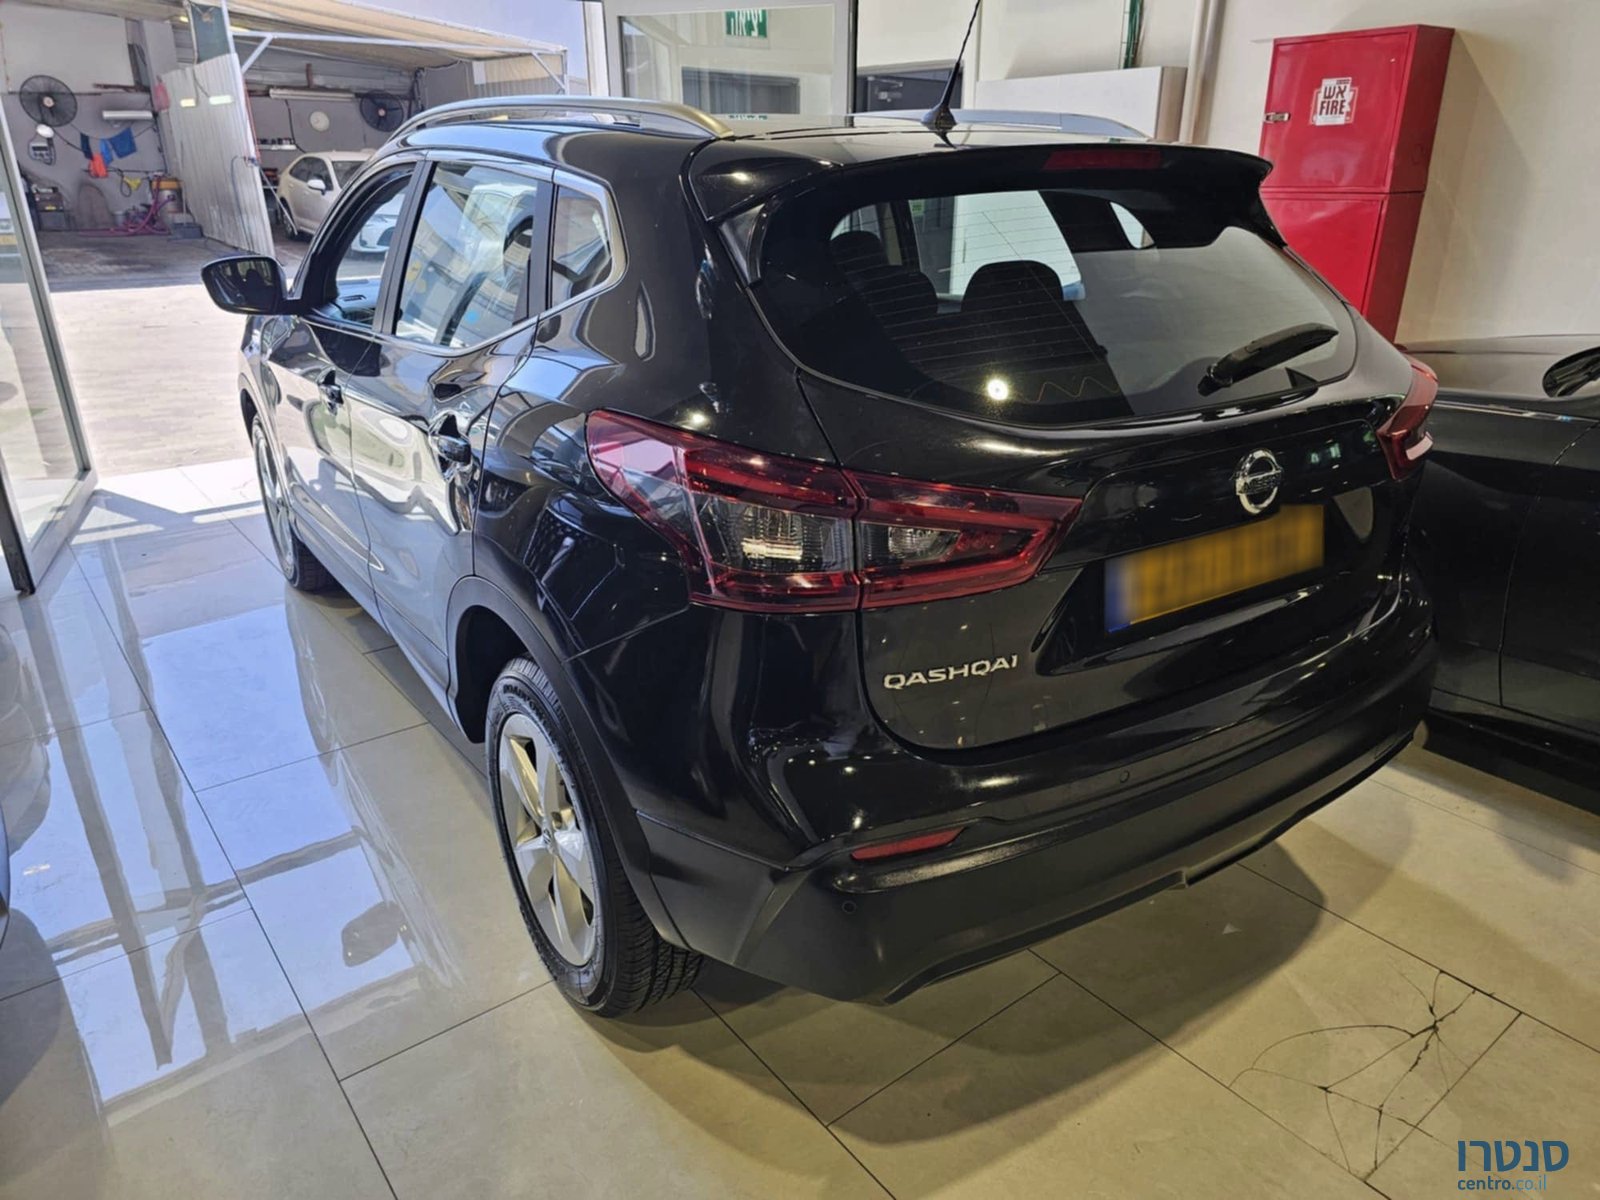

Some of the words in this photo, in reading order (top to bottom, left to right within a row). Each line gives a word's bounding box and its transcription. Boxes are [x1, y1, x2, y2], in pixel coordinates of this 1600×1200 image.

[1323, 85, 1347, 99] אש
[1319, 99, 1346, 116] FIRE
[884, 654, 1018, 690] QASHQAI
